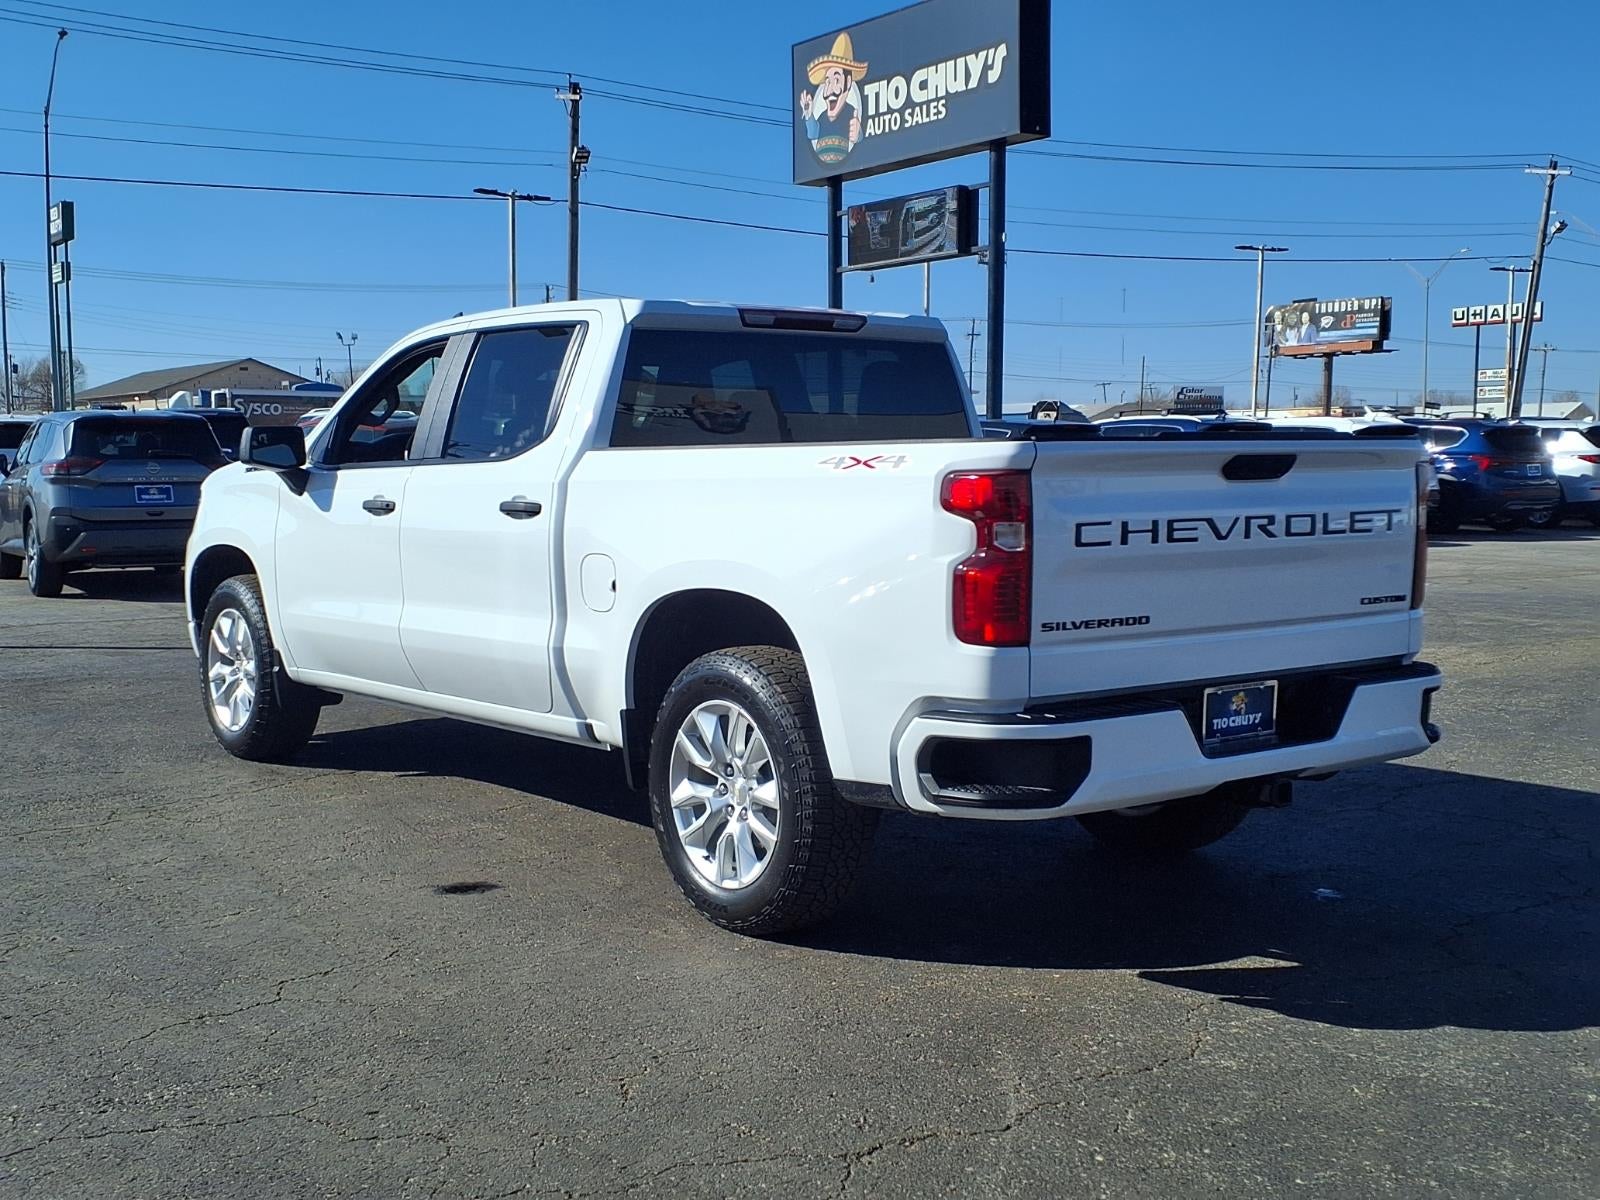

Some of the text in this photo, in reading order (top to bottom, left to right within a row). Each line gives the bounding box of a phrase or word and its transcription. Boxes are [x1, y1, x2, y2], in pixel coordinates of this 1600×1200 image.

[864, 43, 1008, 116] TIO CHUY'S
[865, 99, 947, 138] AUTO SALES
[1315, 297, 1382, 314] THUNDER UP!
[1180, 386, 1204, 394] Color
[1074, 509, 1402, 548] CHEVROLET
[1360, 594, 1407, 606] CUSTOM
[1041, 615, 1151, 632] SILVERADO
[1212, 717, 1228, 730] TIO
